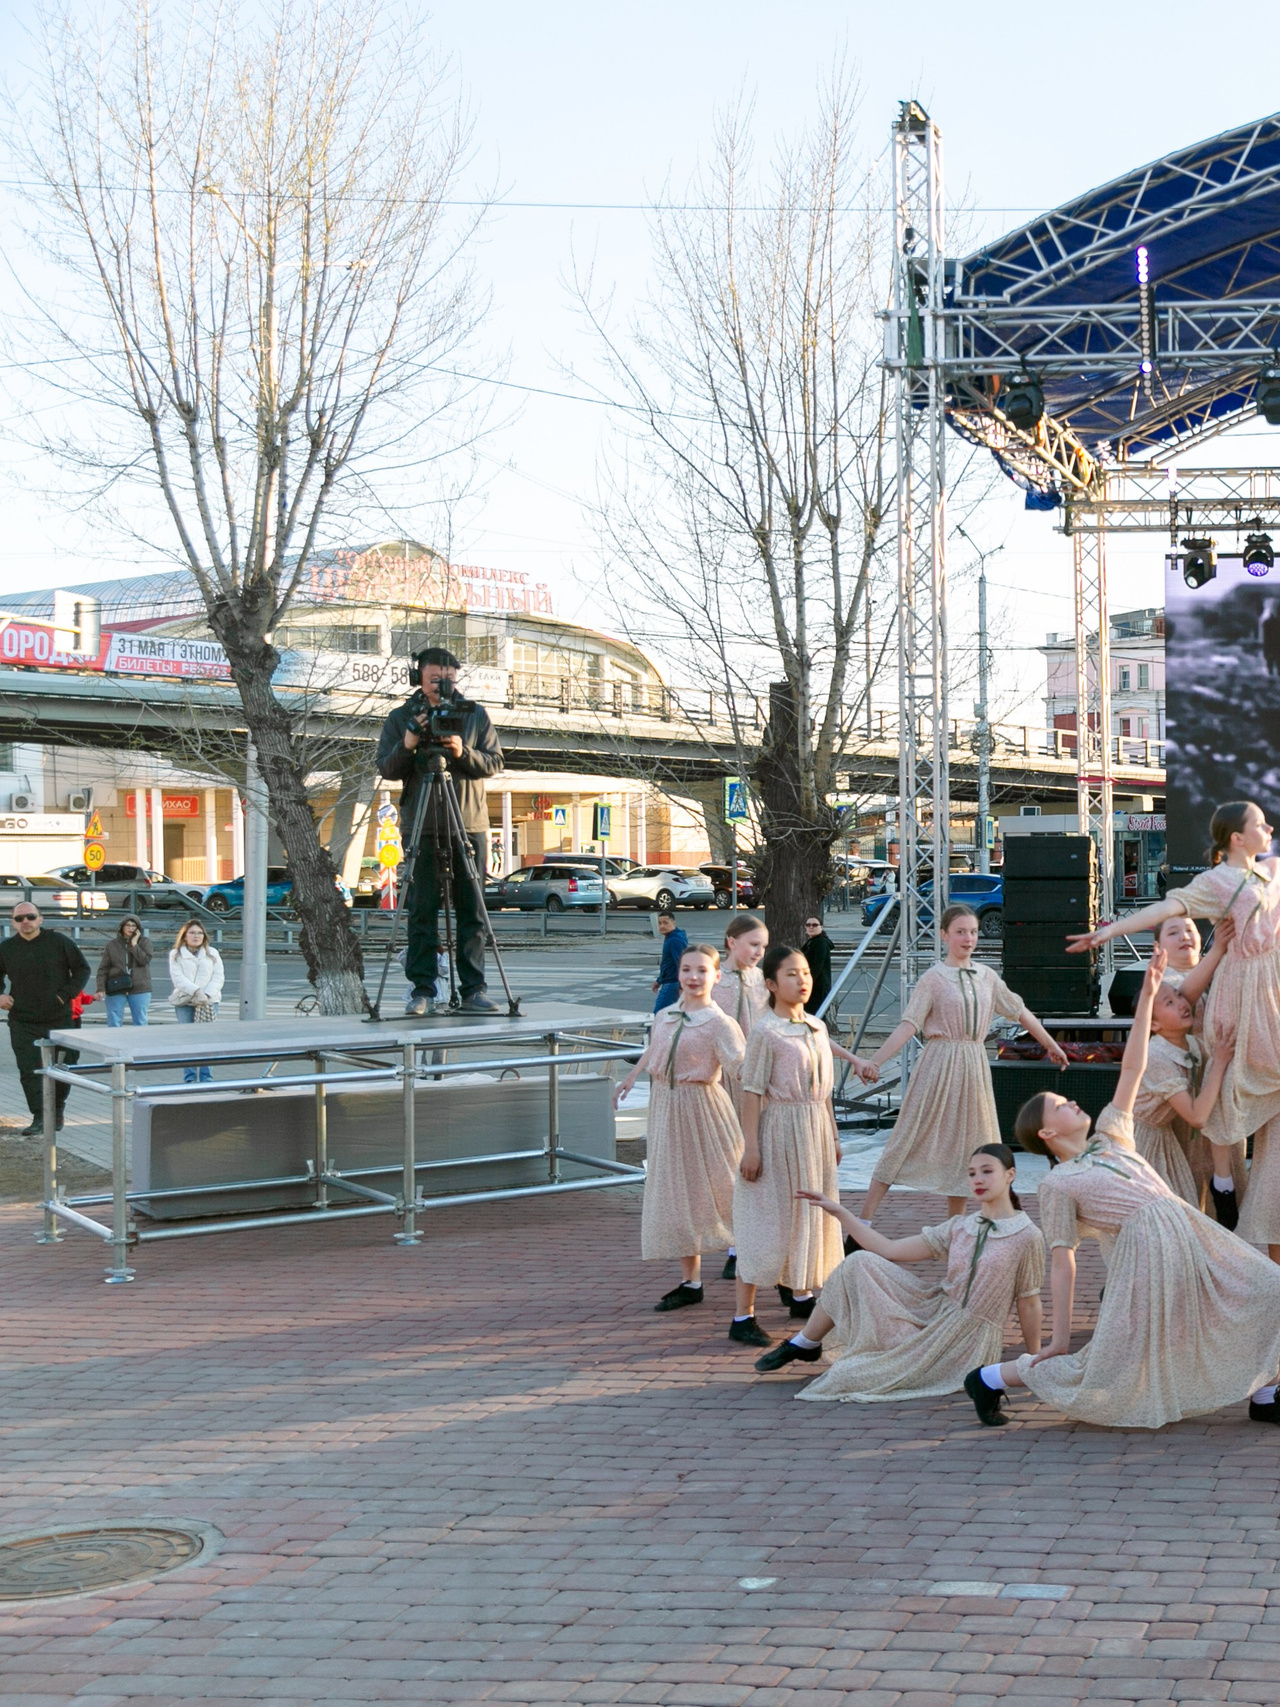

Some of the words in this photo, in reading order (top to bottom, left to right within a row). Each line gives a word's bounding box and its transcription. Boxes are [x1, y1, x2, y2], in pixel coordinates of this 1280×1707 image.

[439, 560, 531, 586] КОМПЛЕКС
[138, 640, 166, 658] МАЯ
[118, 656, 177, 673] БИЛЕТЫ:
[89, 850, 102, 862] 50
